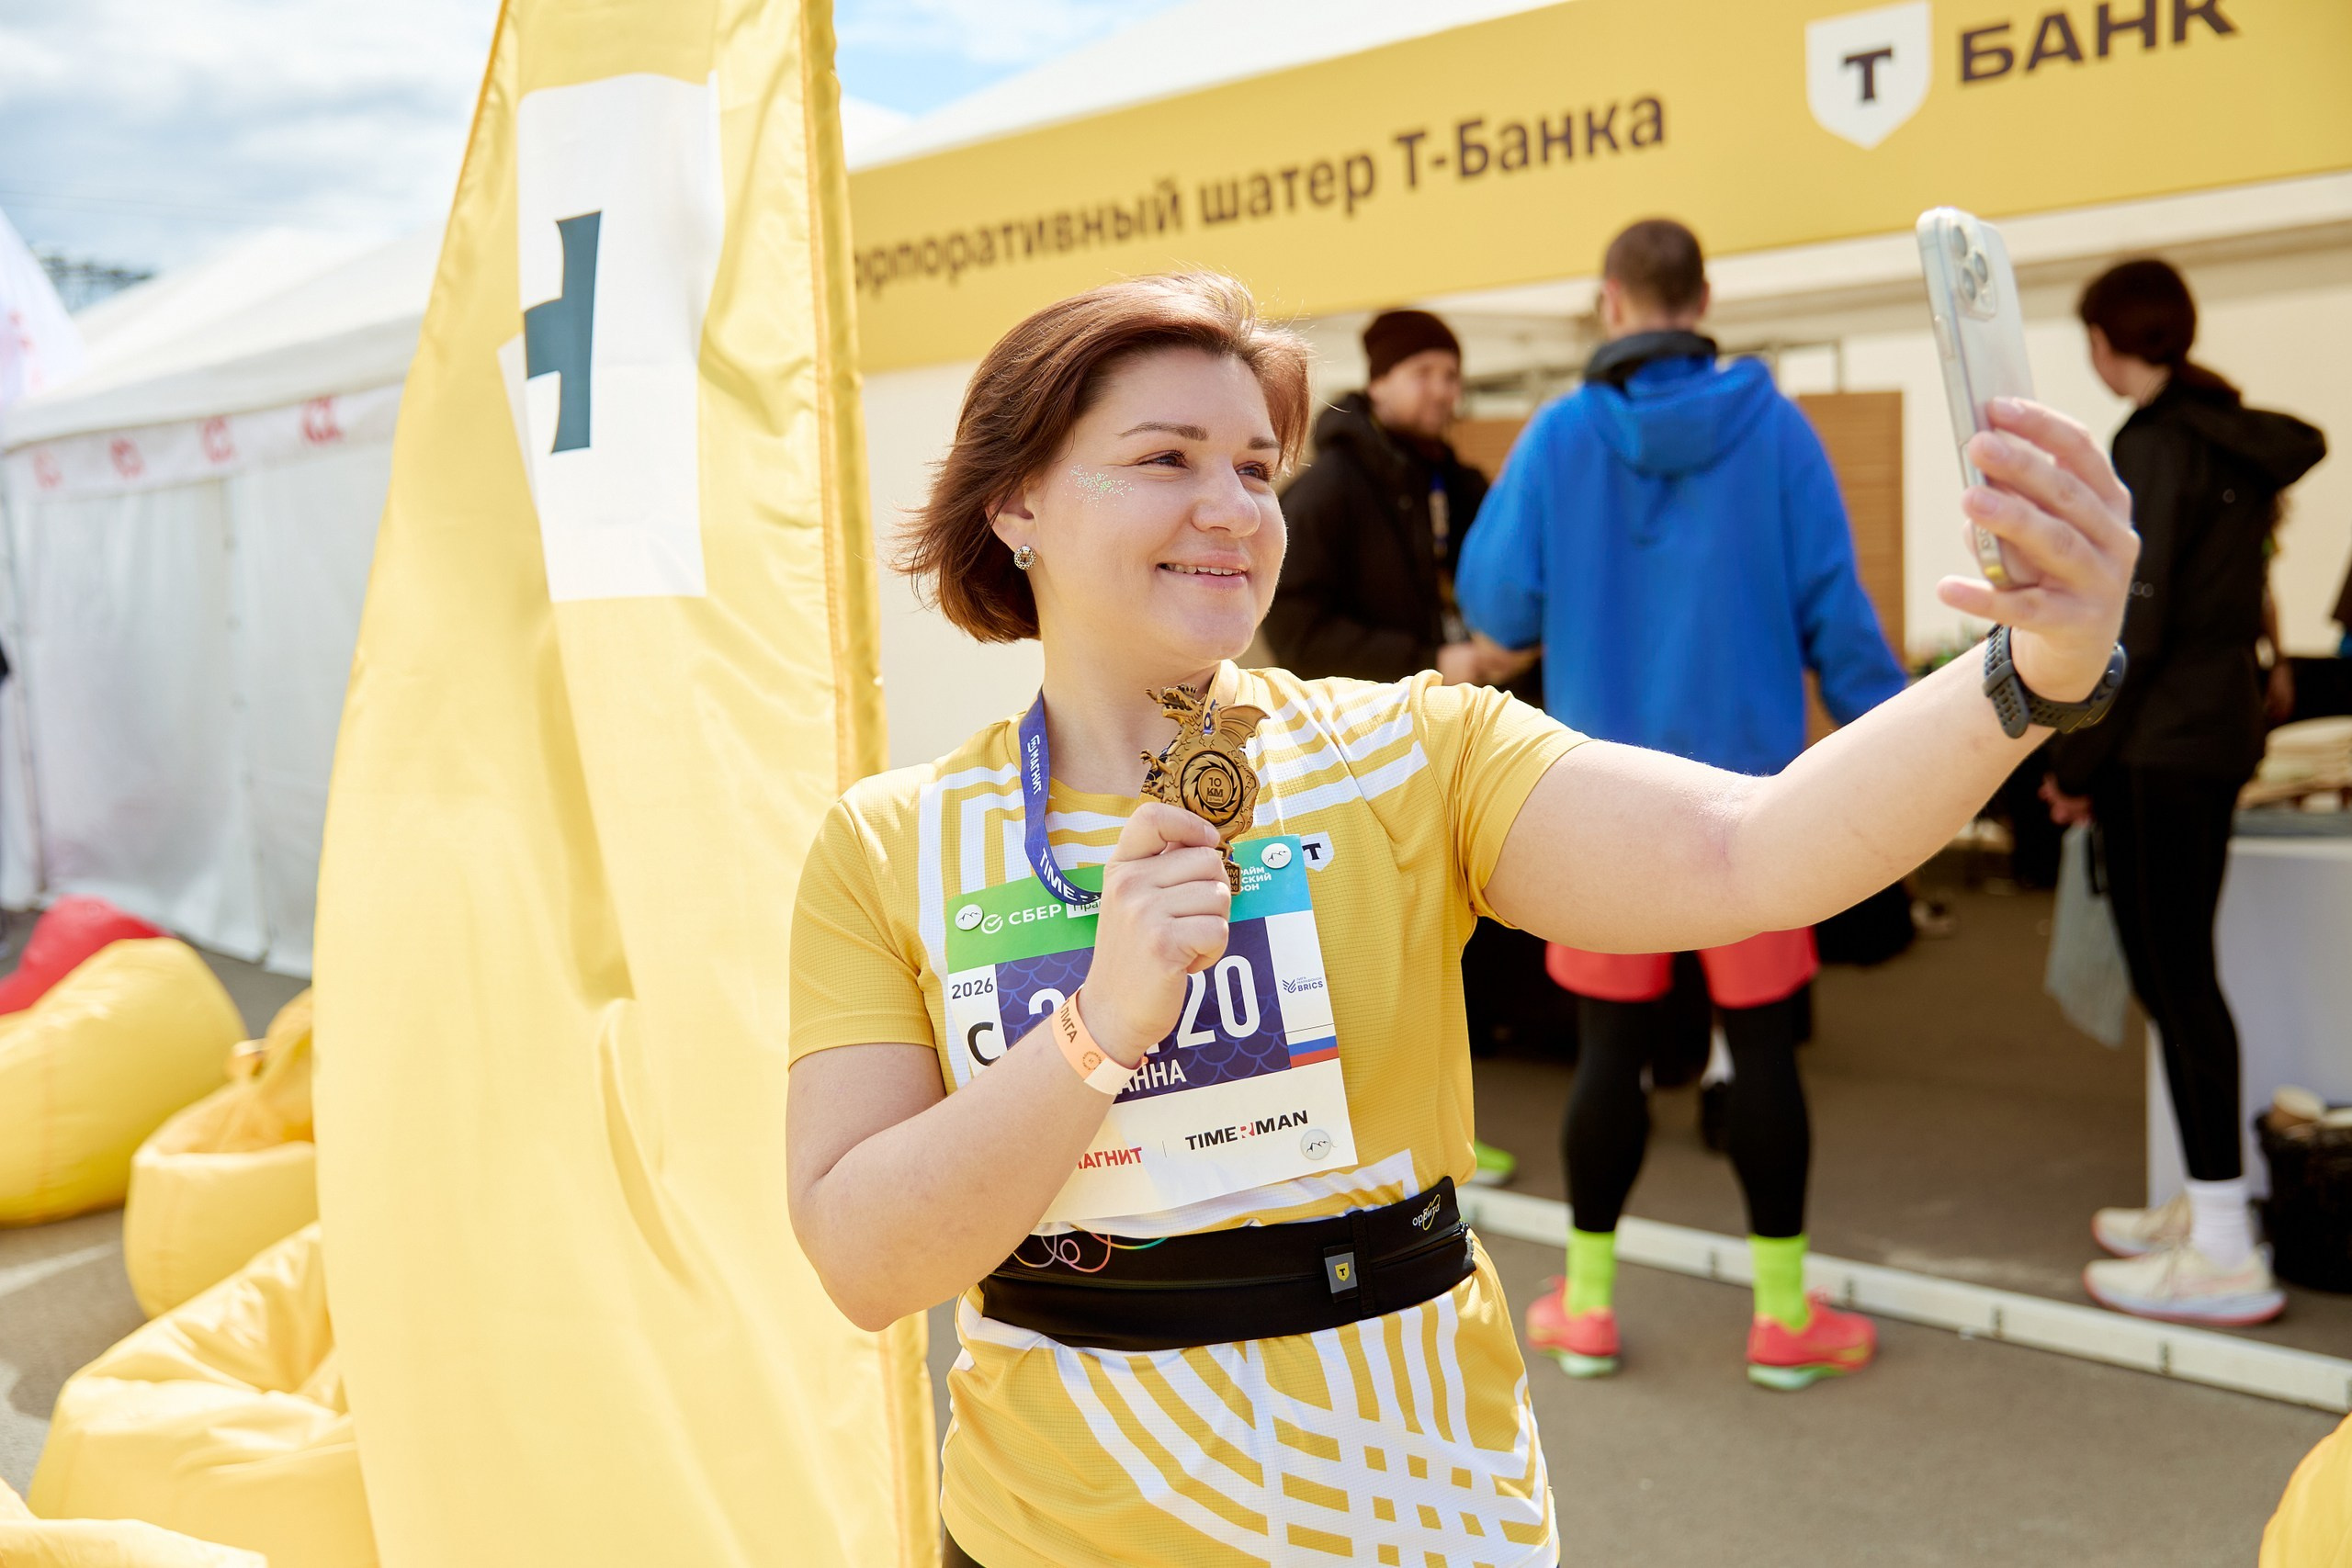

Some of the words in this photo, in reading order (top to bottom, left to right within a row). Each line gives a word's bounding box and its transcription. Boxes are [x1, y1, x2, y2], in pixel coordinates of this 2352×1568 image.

[1958, 0, 2238, 86] БАНК
[854, 178, 1182, 300] орпоративный
[1200, 152, 1375, 215] шатер
[1395, 94, 1666, 189] Т-Банка
[1029, 747, 1042, 795] МАГНИТ
[1208, 776, 1222, 787] 10
[1241, 865, 1265, 876] АЙМ
[1241, 872, 1272, 884] СКИЙ
[1008, 903, 1062, 925] СБЕР
[951, 977, 994, 1000] 2026
[1297, 980, 1324, 992] BRICS
[1185, 1110, 1308, 1151] TIMERMAN
